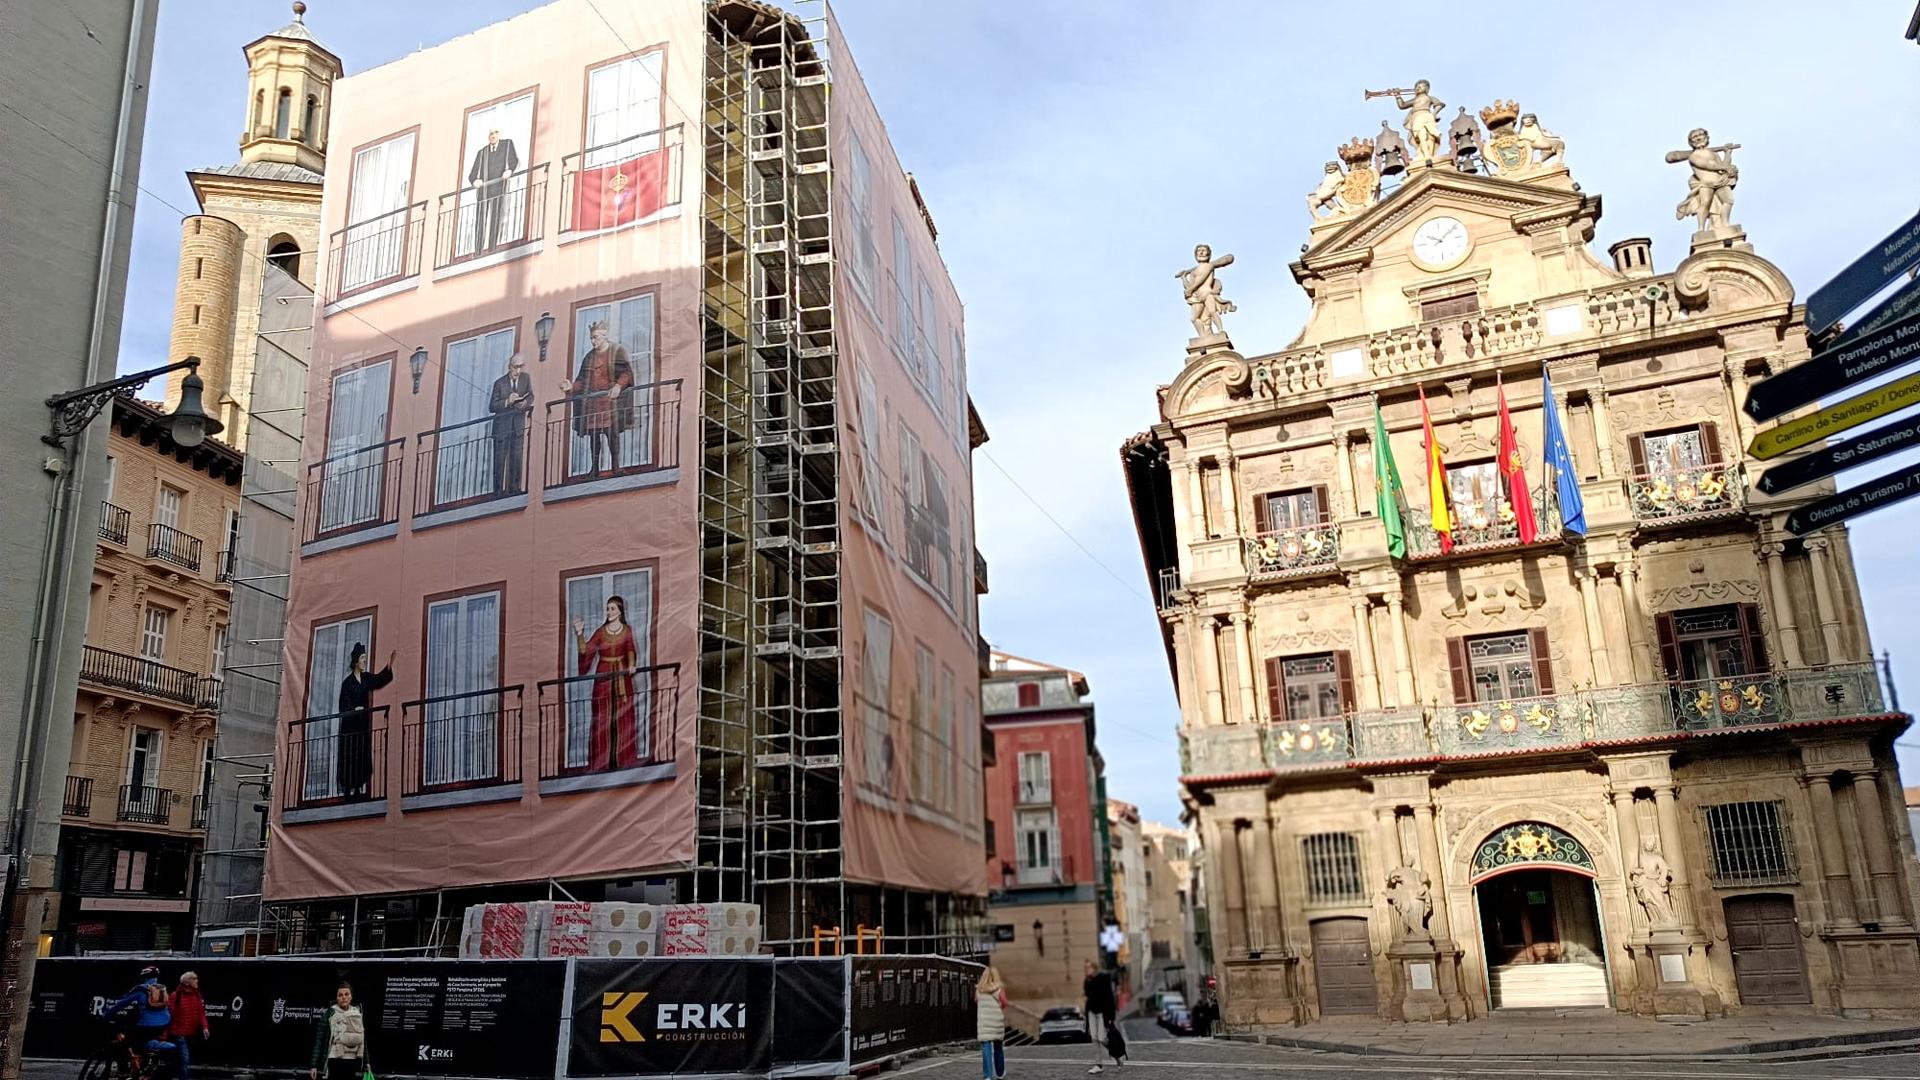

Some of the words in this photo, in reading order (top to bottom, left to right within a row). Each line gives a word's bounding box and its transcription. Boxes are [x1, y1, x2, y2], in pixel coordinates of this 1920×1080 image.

[1884, 232, 1912, 257] Museo
[1838, 335, 1894, 365] Pamplona
[1845, 354, 1888, 378] Iruñeko
[1776, 424, 1814, 444] Camino
[1816, 417, 1829, 429] de
[1831, 398, 1879, 422] Santiago
[1888, 383, 1920, 401] Done
[1832, 449, 1855, 463] San
[1857, 428, 1914, 454] Saturnino
[1809, 503, 1845, 522] Oficina
[1847, 498, 1860, 509] de
[1860, 482, 1905, 503] Turismo
[664, 1032, 746, 1042] CONSTRUCCIÓN
